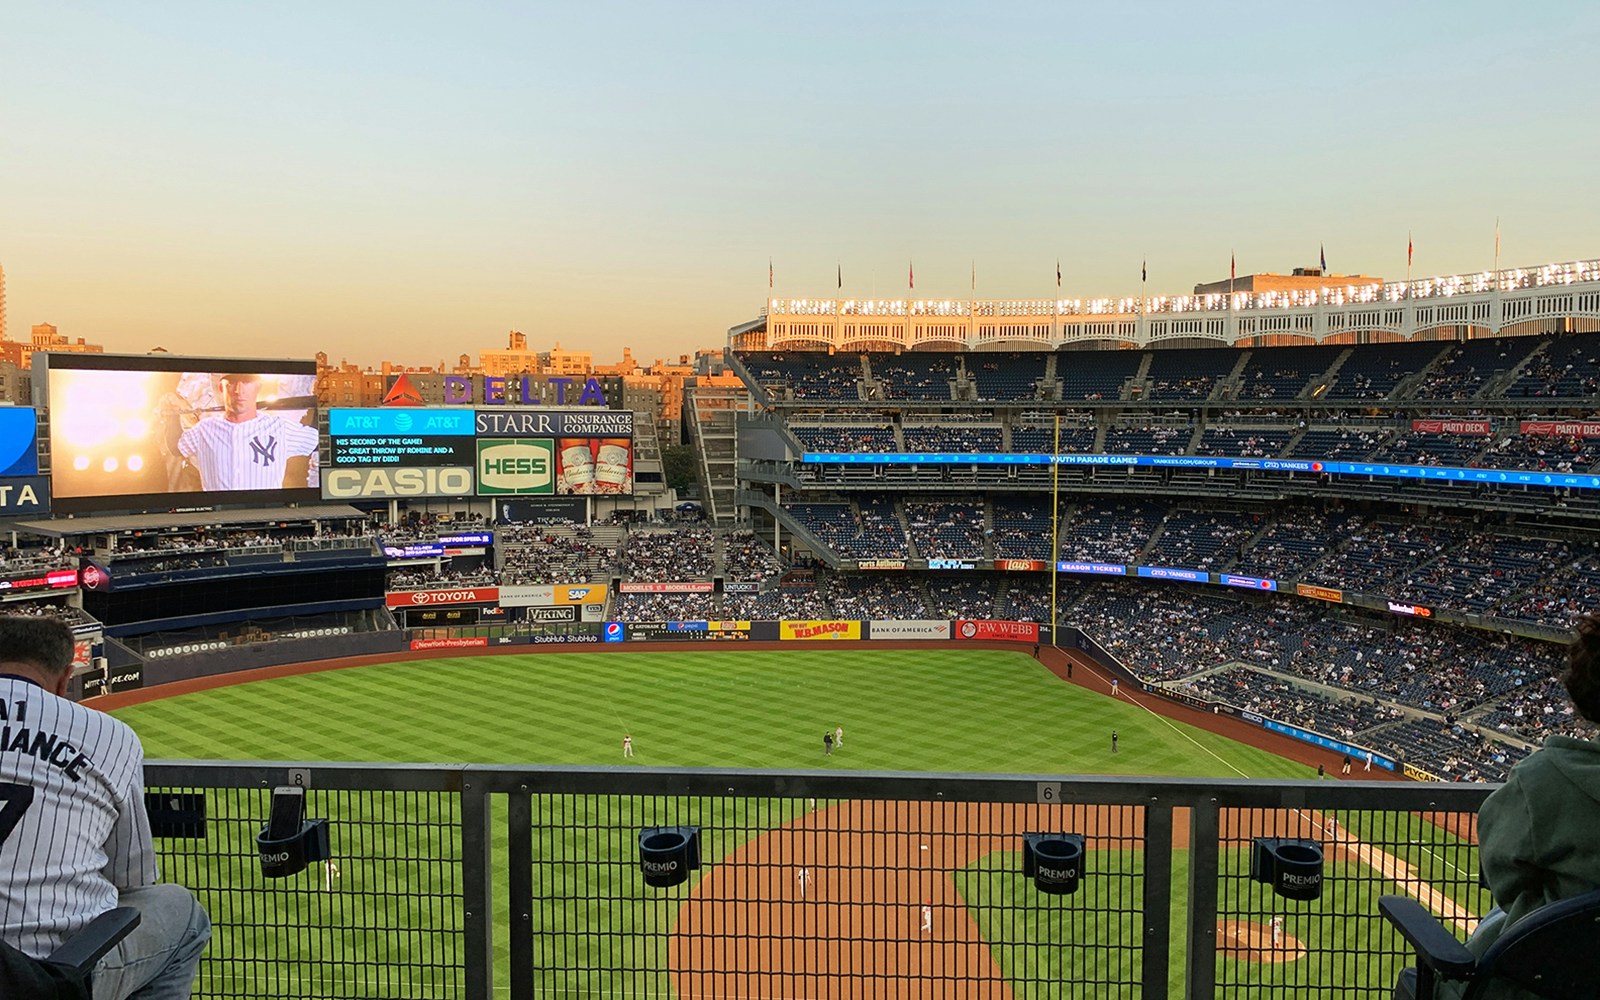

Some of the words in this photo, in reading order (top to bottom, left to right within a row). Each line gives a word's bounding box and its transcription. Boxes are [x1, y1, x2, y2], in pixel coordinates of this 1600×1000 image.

[445, 376, 607, 406] DELTA
[345, 416, 380, 429] AT&T
[427, 416, 461, 429] AT&T
[476, 414, 555, 433] STARR
[564, 415, 632, 424] INSURANCE
[564, 424, 632, 434] COMPANIES
[1442, 423, 1464, 432] PARTY
[1465, 423, 1485, 432] DECK
[1555, 425, 1581, 434] PARTY
[485, 458, 546, 475] HESS
[328, 468, 471, 497] CASIO
[0, 485, 39, 507] TA
[876, 560, 905, 568] Authority
[1092, 565, 1122, 573] TICKETS
[1168, 570, 1196, 579] YANKEES
[430, 592, 476, 602] TOYOTA
[568, 590, 587, 599] SAP
[483, 607, 504, 616] FedEx
[530, 609, 571, 619] VIKING
[978, 622, 997, 633] F.W.
[999, 623, 1033, 635] WEBB
[534, 635, 565, 644] StubHub
[1242, 711, 1263, 723] GEICO
[294, 773, 303, 786] 8
[1043, 786, 1053, 800] 6
[643, 860, 678, 872] PREMIO
[1039, 865, 1076, 880] PREMIO
[1282, 871, 1321, 885] PREMIO
